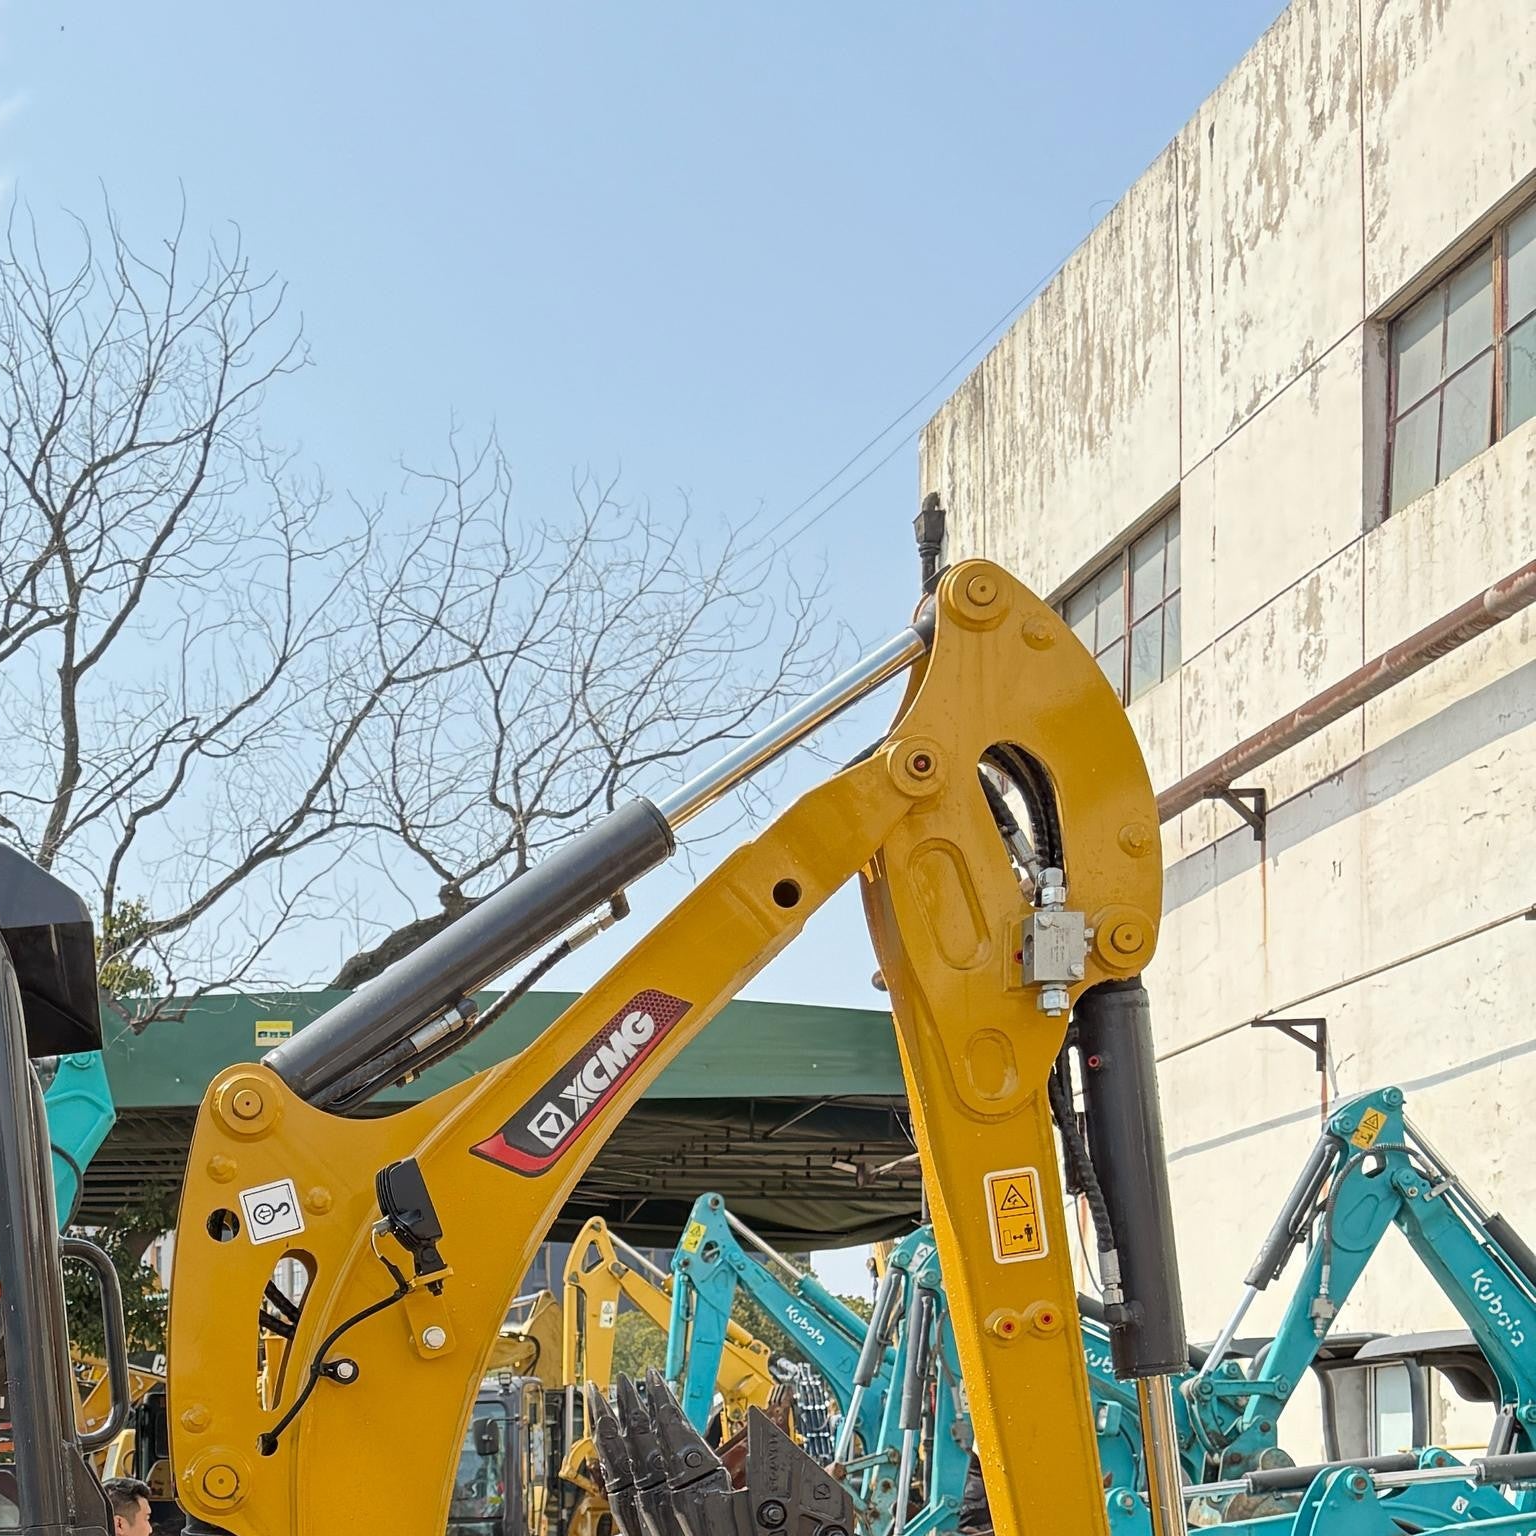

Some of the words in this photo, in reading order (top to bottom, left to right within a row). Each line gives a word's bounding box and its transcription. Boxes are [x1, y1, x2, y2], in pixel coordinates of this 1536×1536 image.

[558, 1011, 655, 1121] XCMG
[785, 1304, 825, 1346] Kubota
[1471, 1268, 1525, 1347] Kubota
